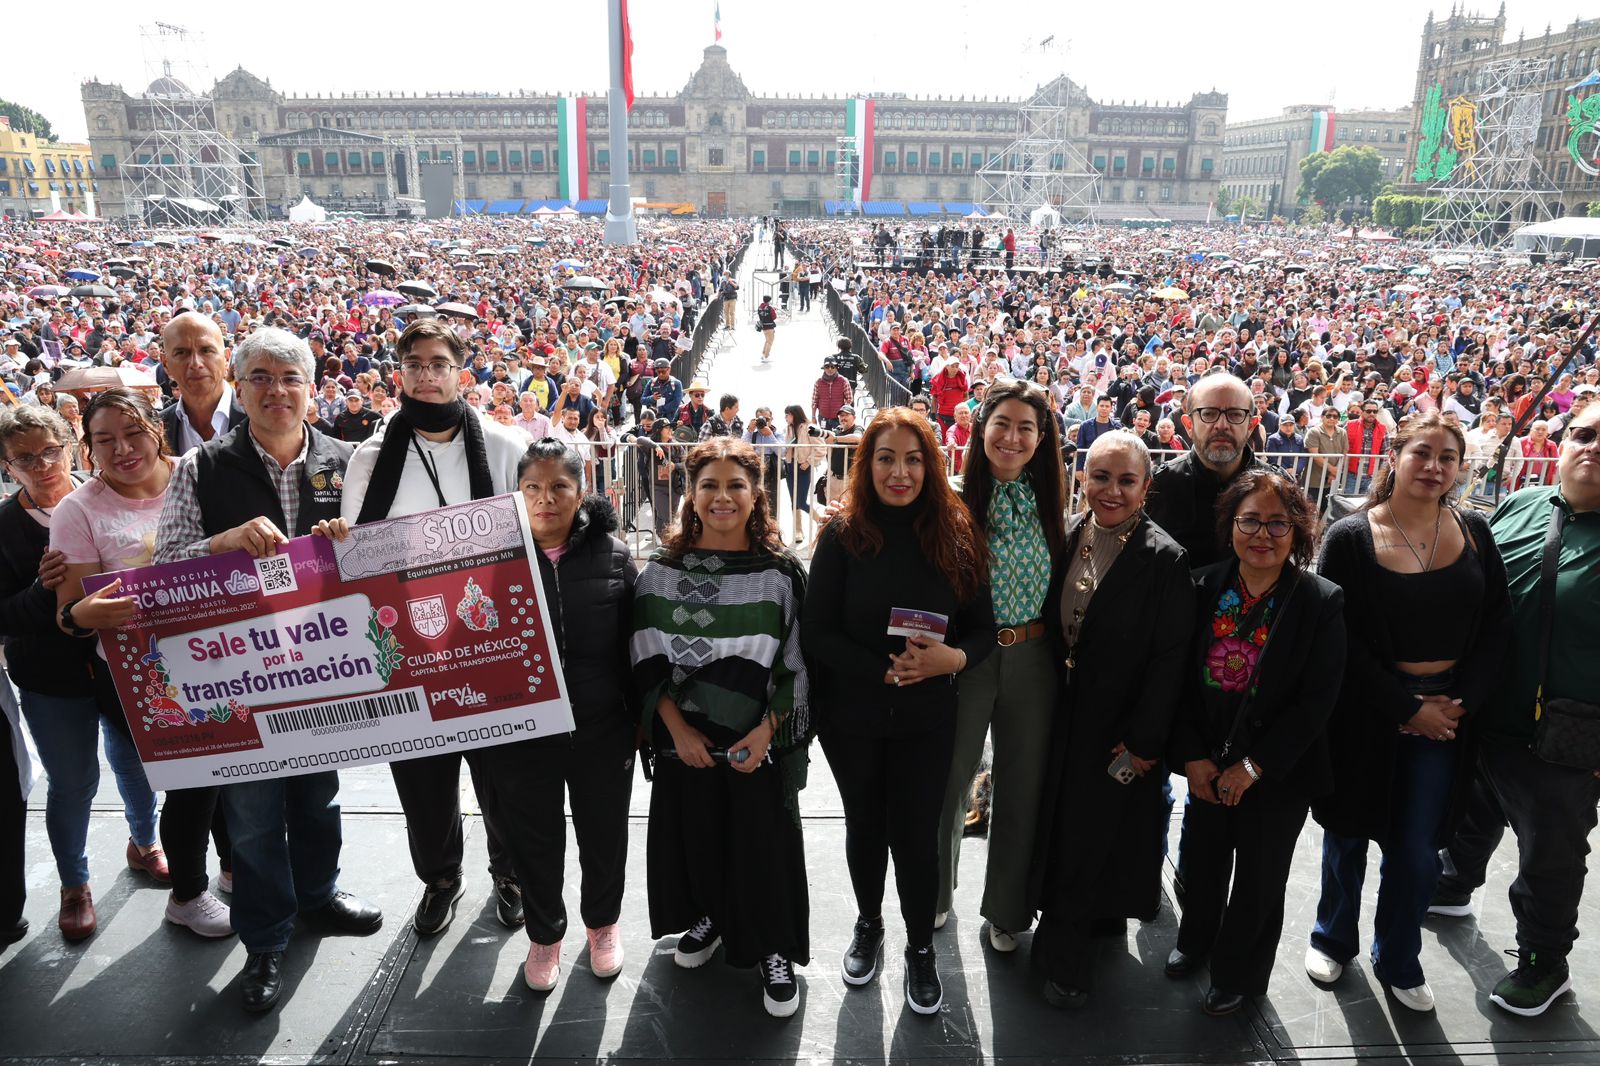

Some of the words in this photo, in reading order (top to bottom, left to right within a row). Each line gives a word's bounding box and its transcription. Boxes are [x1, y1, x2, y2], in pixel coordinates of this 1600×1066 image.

[352, 528, 395, 543] VALOR
[422, 508, 492, 552] $100
[356, 542, 415, 560] NOMINAL
[410, 551, 444, 564] PESOS
[407, 562, 452, 578] Equivalente
[460, 558, 475, 567] 100
[476, 554, 499, 566] pesos
[500, 552, 514, 560] MN
[112, 580, 166, 594] OGRAMA
[173, 569, 218, 584] SOCIAL
[151, 606, 190, 618] COMUNIDAD
[200, 600, 227, 609] ABASTO
[155, 614, 187, 625] Mercomuna
[188, 610, 208, 621] Ciudad
[208, 609, 216, 617] de
[217, 606, 240, 616] México,
[187, 631, 247, 662] Sale
[248, 624, 281, 652] tu
[285, 612, 348, 646] vale
[262, 654, 286, 670] por
[288, 648, 304, 663] la
[407, 650, 452, 667] CIUDAD
[456, 646, 472, 658] DE
[474, 636, 520, 654] MÉXICO
[410, 666, 438, 677] CAPITAL
[438, 664, 448, 672] DE
[449, 662, 458, 670] LA
[460, 651, 524, 668] TRANSFORMACIÓN
[182, 652, 372, 703] transformación
